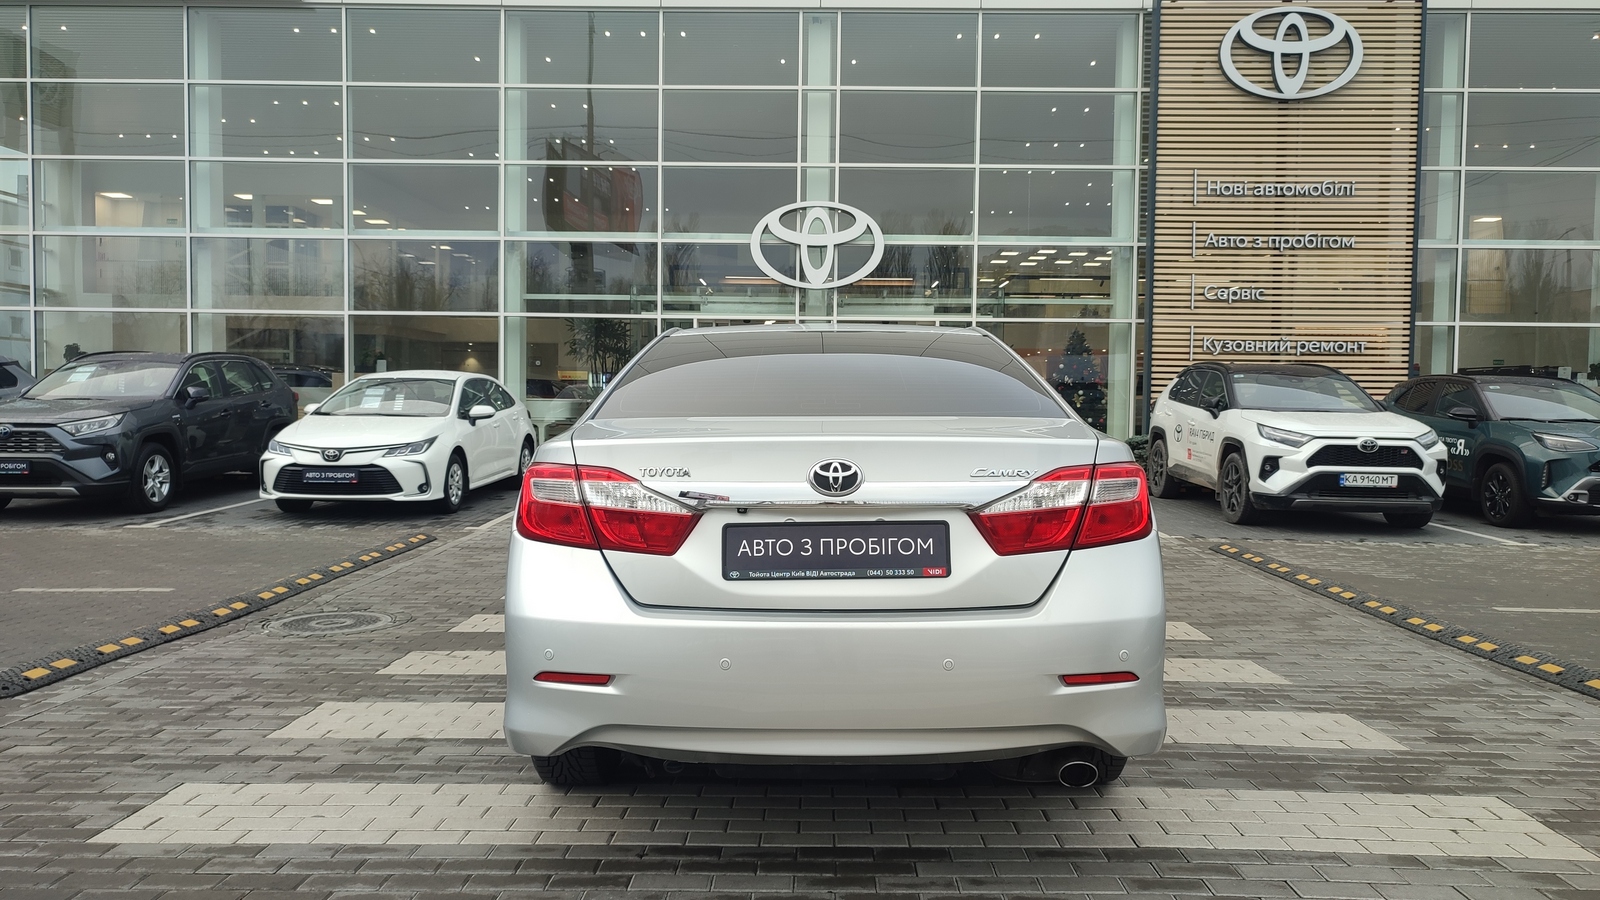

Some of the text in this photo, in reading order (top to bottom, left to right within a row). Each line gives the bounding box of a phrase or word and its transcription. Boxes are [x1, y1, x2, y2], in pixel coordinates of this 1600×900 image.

[1206, 179, 1356, 196] Нові автомобілі
[1204, 232, 1356, 252] Авто з пробігом
[1203, 284, 1266, 304] Сервіс
[1202, 336, 1368, 357] Кузовний ремонт
[639, 466, 692, 478] TOYOTA
[1447, 459, 1464, 472] OSS
[969, 467, 1039, 480] CAMRY
[1360, 475, 1380, 484] 9140
[737, 537, 934, 557] АВТО З ПРОБІГОМ
[771, 571, 791, 579] Центр
[819, 570, 856, 578] Автострада
